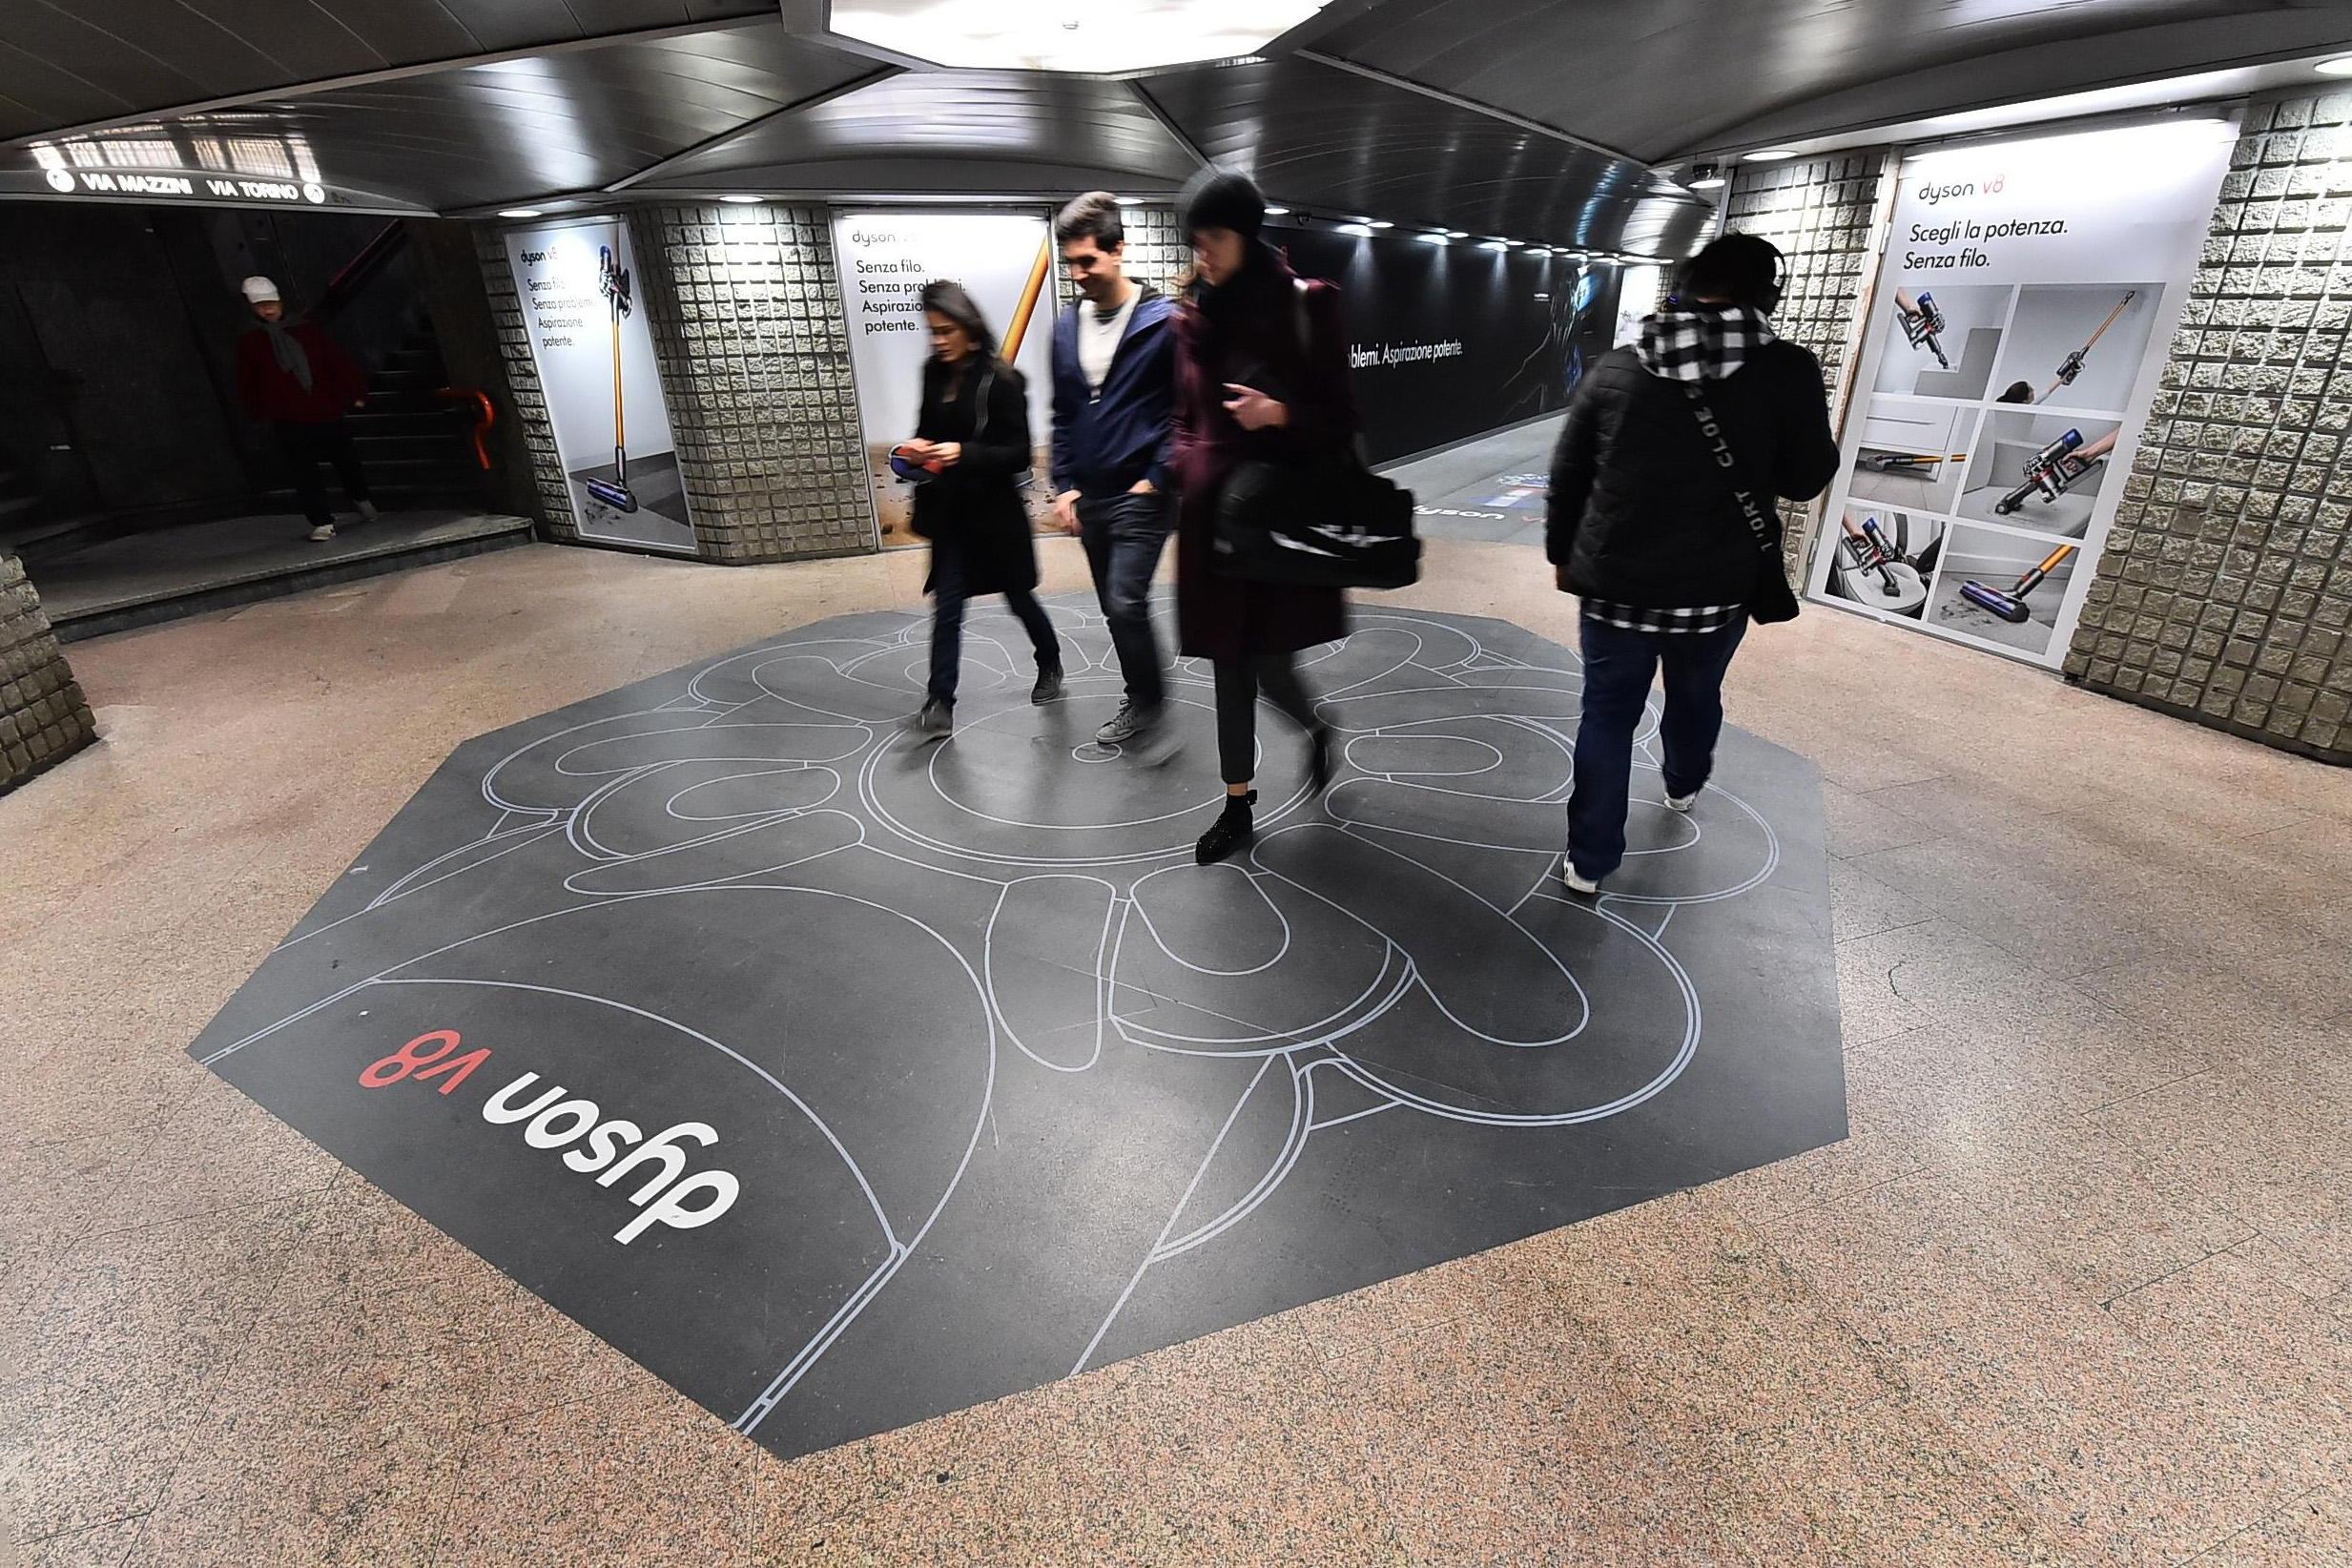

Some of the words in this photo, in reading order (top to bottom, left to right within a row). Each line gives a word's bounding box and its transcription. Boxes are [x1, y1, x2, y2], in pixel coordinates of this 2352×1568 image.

[80, 174, 117, 191] VIA
[117, 175, 193, 195] MAZZINI
[206, 179, 238, 196] VIA
[238, 181, 299, 200] TORINO
[1918, 181, 1974, 205] dyson
[852, 229, 896, 247] dyson
[1909, 220, 1962, 245] Scegli
[1965, 219, 1980, 238] la
[1984, 219, 2068, 242] potenza.
[520, 249, 547, 266] dyson
[856, 259, 898, 274] Senza
[900, 258, 925, 273] filo.
[1903, 251, 1955, 270] Senza
[1959, 248, 1991, 268] filo.
[526, 279, 552, 292] Senza
[858, 279, 900, 294] Senza
[532, 298, 557, 310] Senza
[861, 298, 923, 316] Aspirazio
[538, 316, 583, 331] Aspirazione
[865, 320, 919, 336] potente.
[542, 335, 575, 350] potente.
[1382, 339, 1434, 369] Aspirazione
[1433, 338, 1464, 364] potente.
[483, 1071, 740, 1246] dyson
